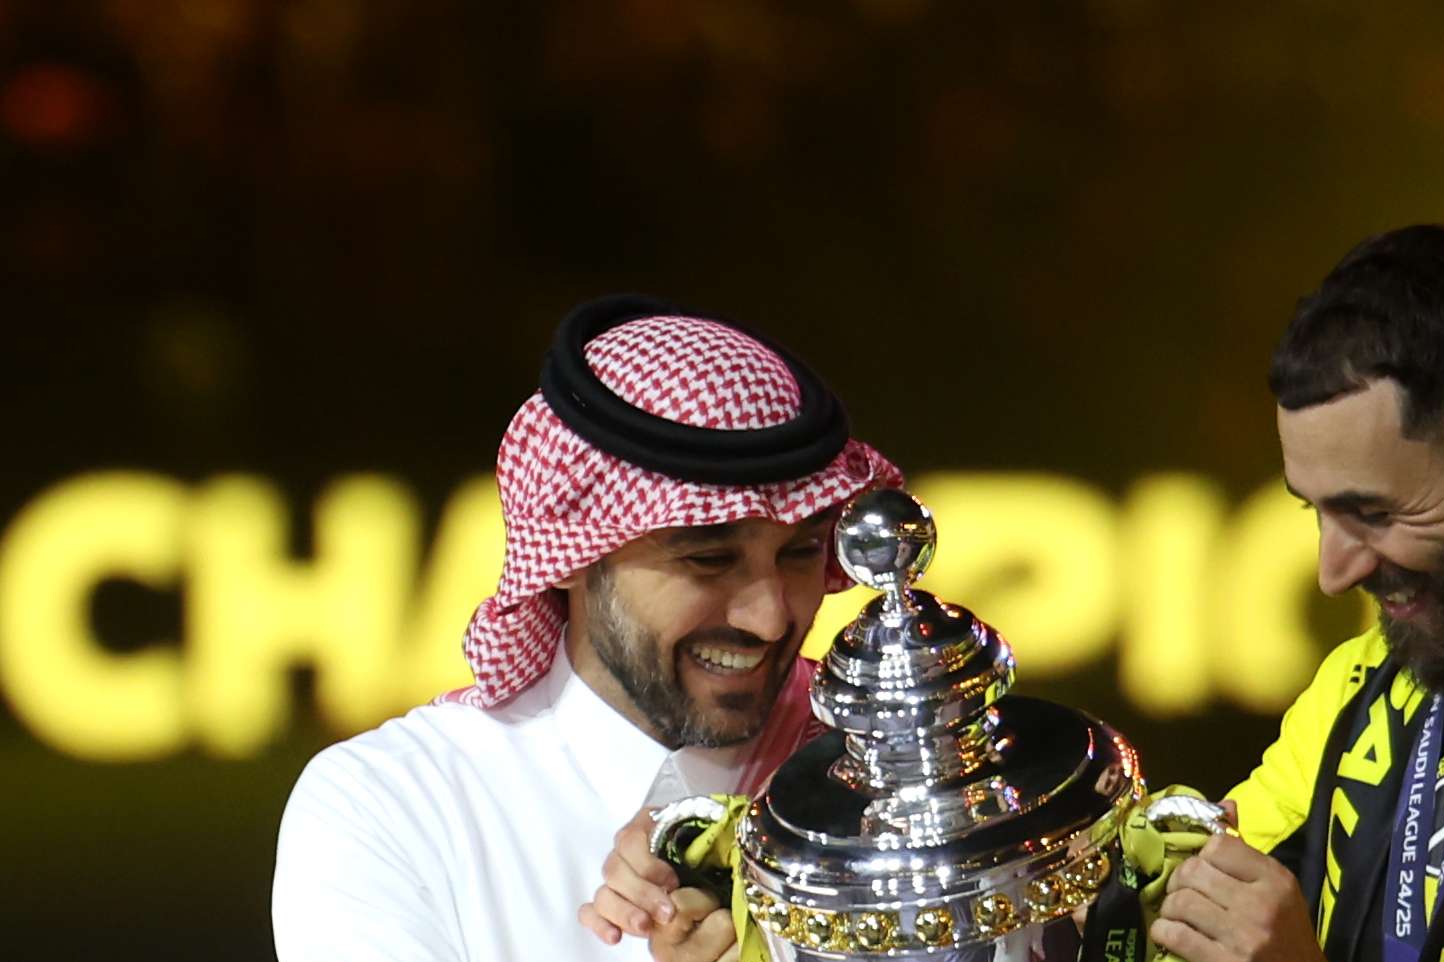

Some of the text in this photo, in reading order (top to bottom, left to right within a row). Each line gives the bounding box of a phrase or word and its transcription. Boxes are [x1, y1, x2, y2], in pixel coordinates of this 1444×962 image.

[1411, 716, 1435, 782] SAUDI
[1403, 783, 1422, 864] LEAGUE
[1395, 869, 1414, 938] 24/25
